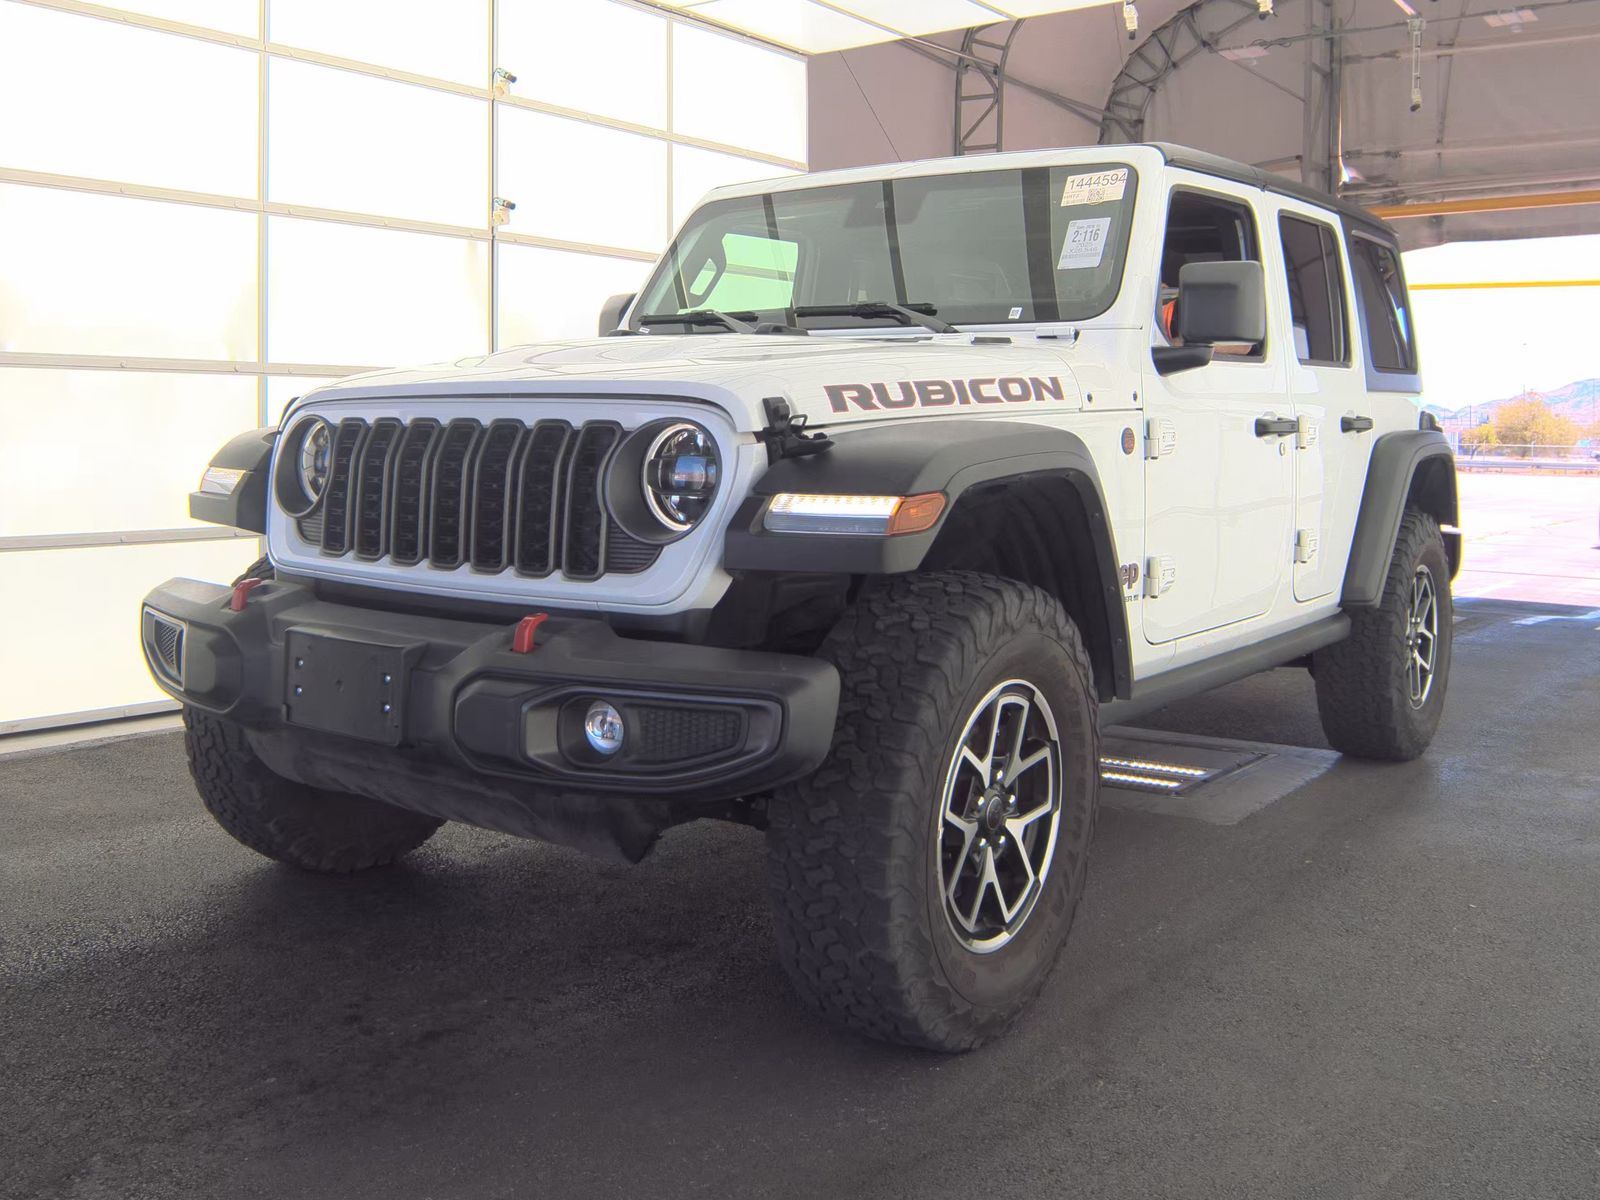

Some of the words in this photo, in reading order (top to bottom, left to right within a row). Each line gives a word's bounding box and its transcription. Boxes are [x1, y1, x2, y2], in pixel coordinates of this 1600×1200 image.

[1070, 172, 1127, 190] 1444594
[1072, 229, 1100, 243] 2:116
[823, 376, 1065, 413] RUBICON
[1119, 563, 1139, 589] ep
